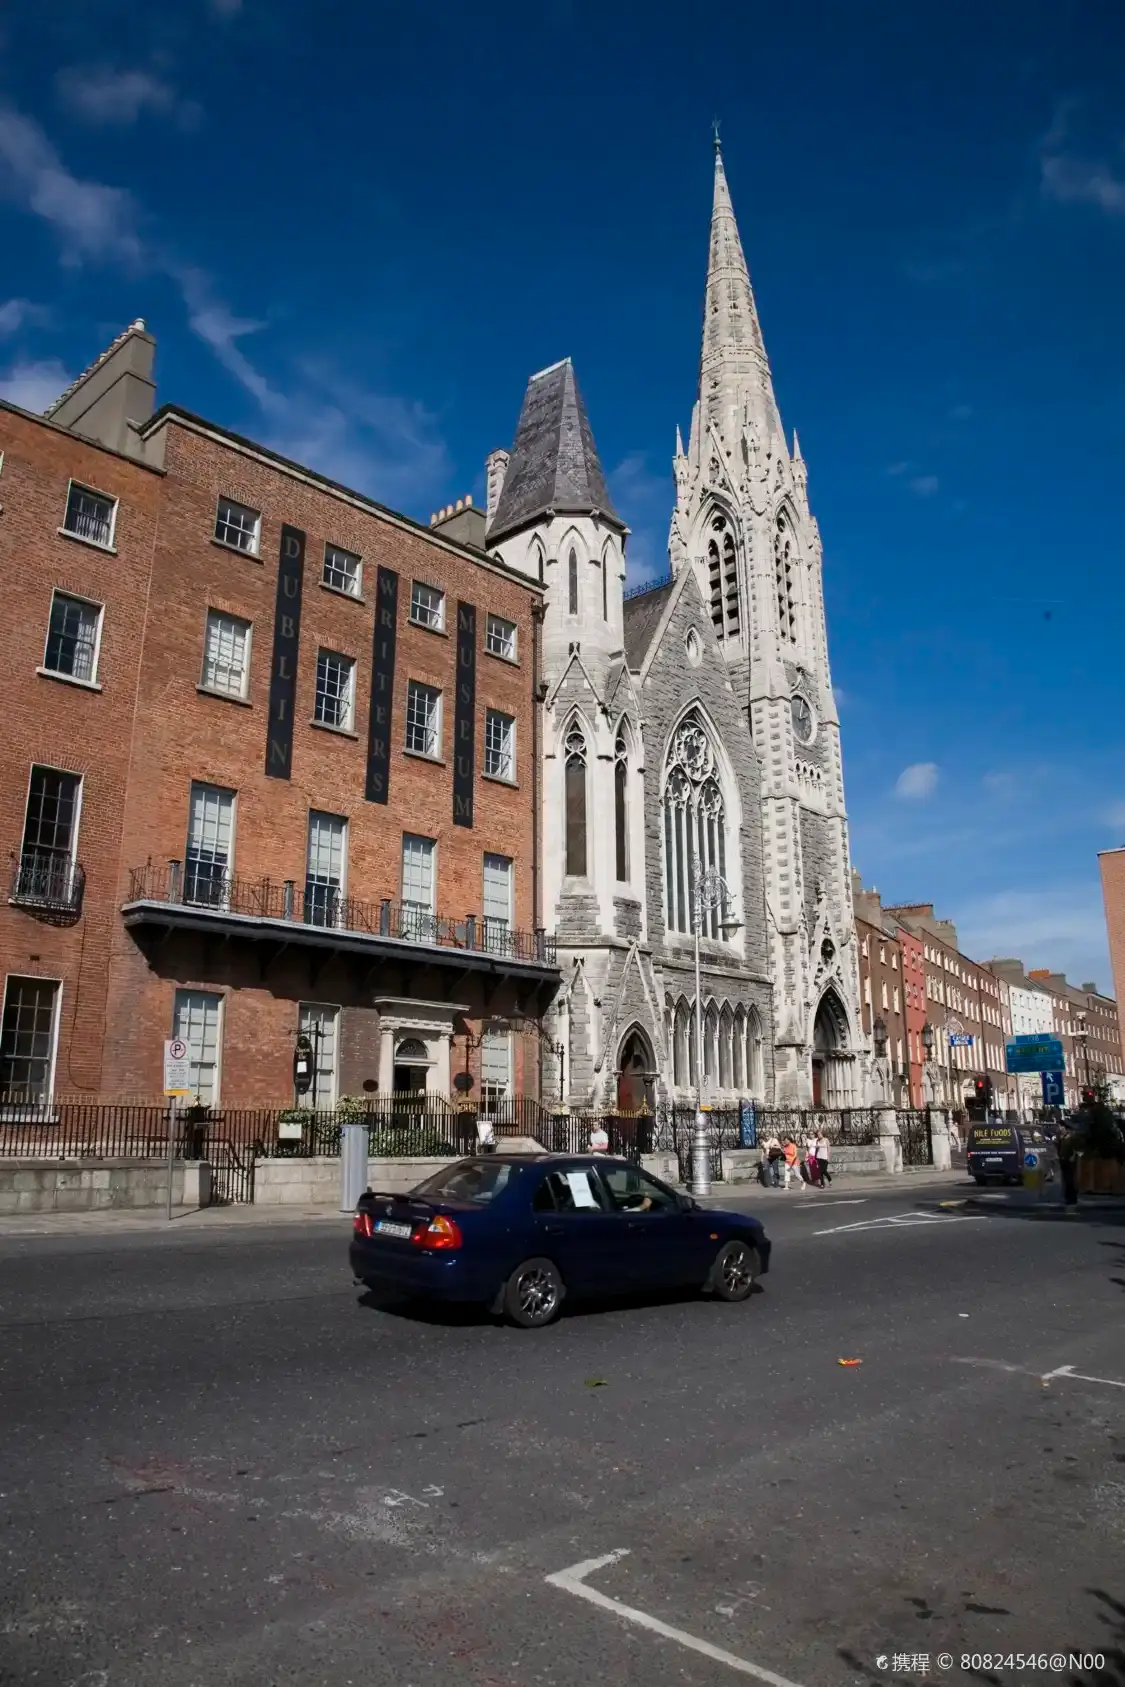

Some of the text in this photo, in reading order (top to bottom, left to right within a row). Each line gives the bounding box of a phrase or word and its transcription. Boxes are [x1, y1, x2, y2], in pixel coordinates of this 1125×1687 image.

[269, 535, 300, 766] DUBLIN
[371, 575, 395, 793] WRITERS
[454, 609, 475, 818] MUSEUM
[1046, 1083, 1060, 1103] P
